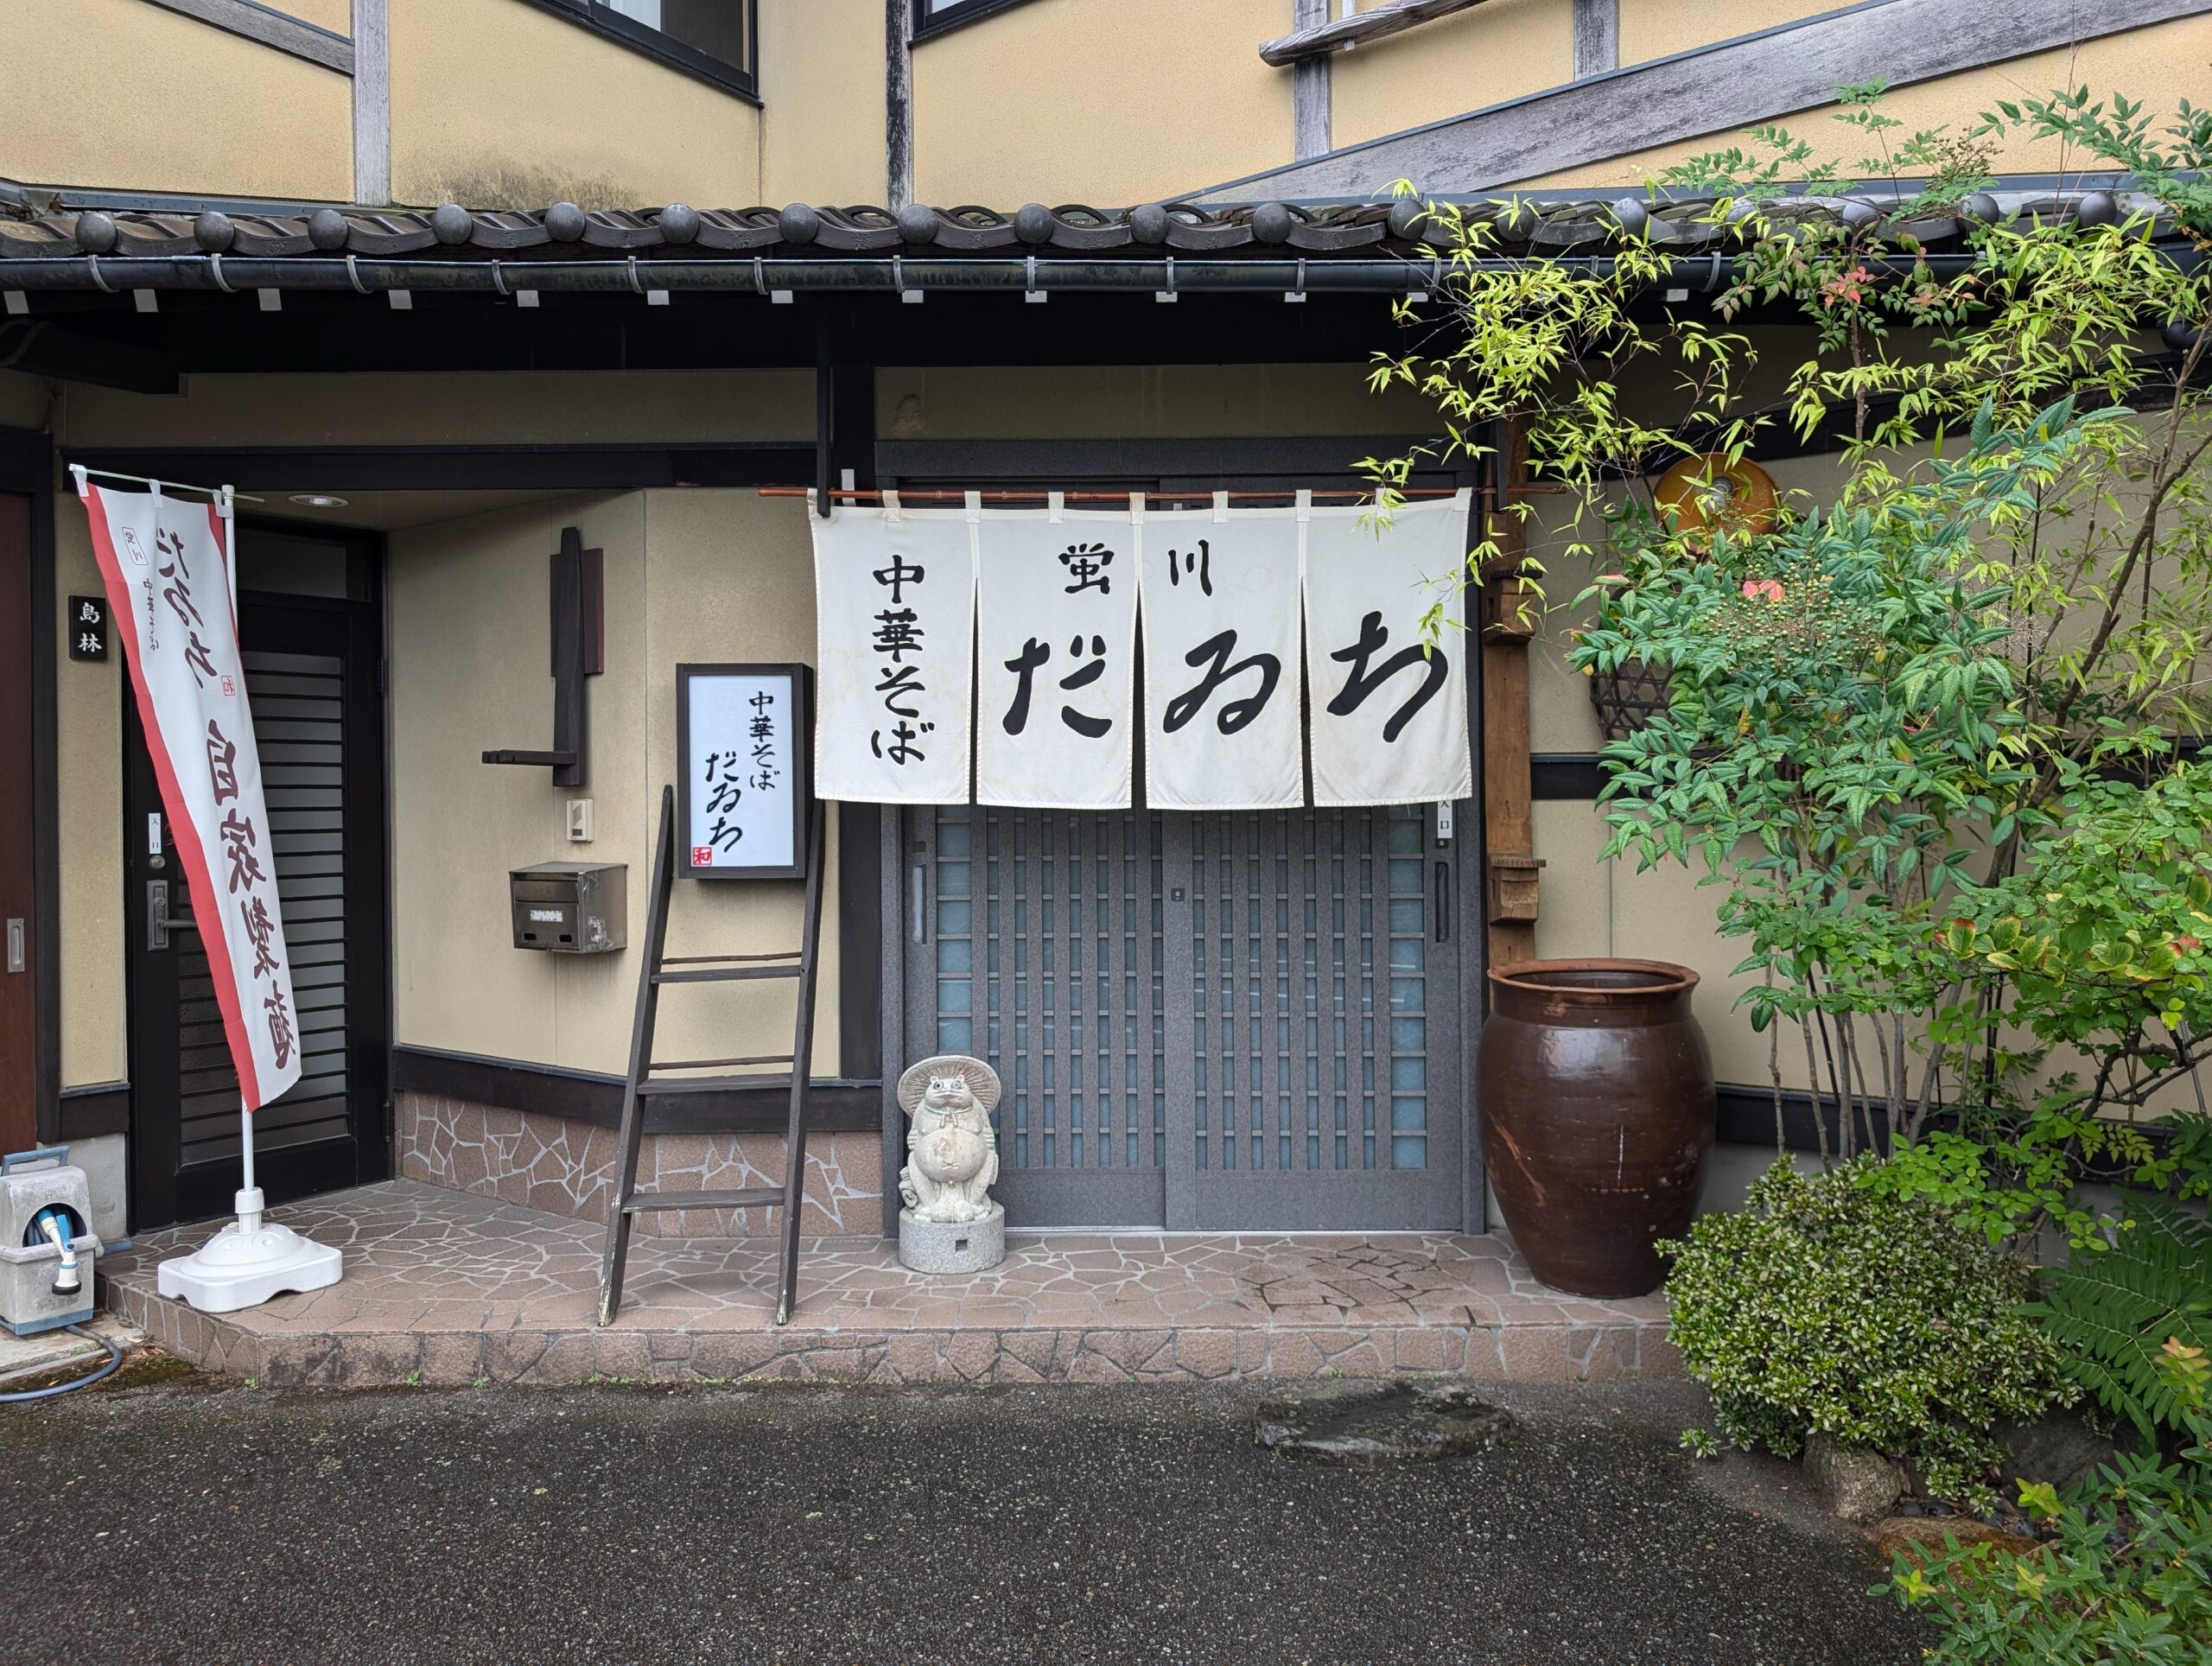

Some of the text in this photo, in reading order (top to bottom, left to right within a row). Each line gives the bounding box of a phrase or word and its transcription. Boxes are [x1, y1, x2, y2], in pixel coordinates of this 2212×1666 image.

[1058, 539, 1212, 596] 蛍川
[78, 601, 102, 652] 島林
[871, 554, 935, 766] 中華そば
[1002, 610, 1449, 743] だゐち
[748, 690, 780, 791] 中華そば
[705, 750, 743, 853] だゐち
[1440, 799, 1450, 830] 入口
